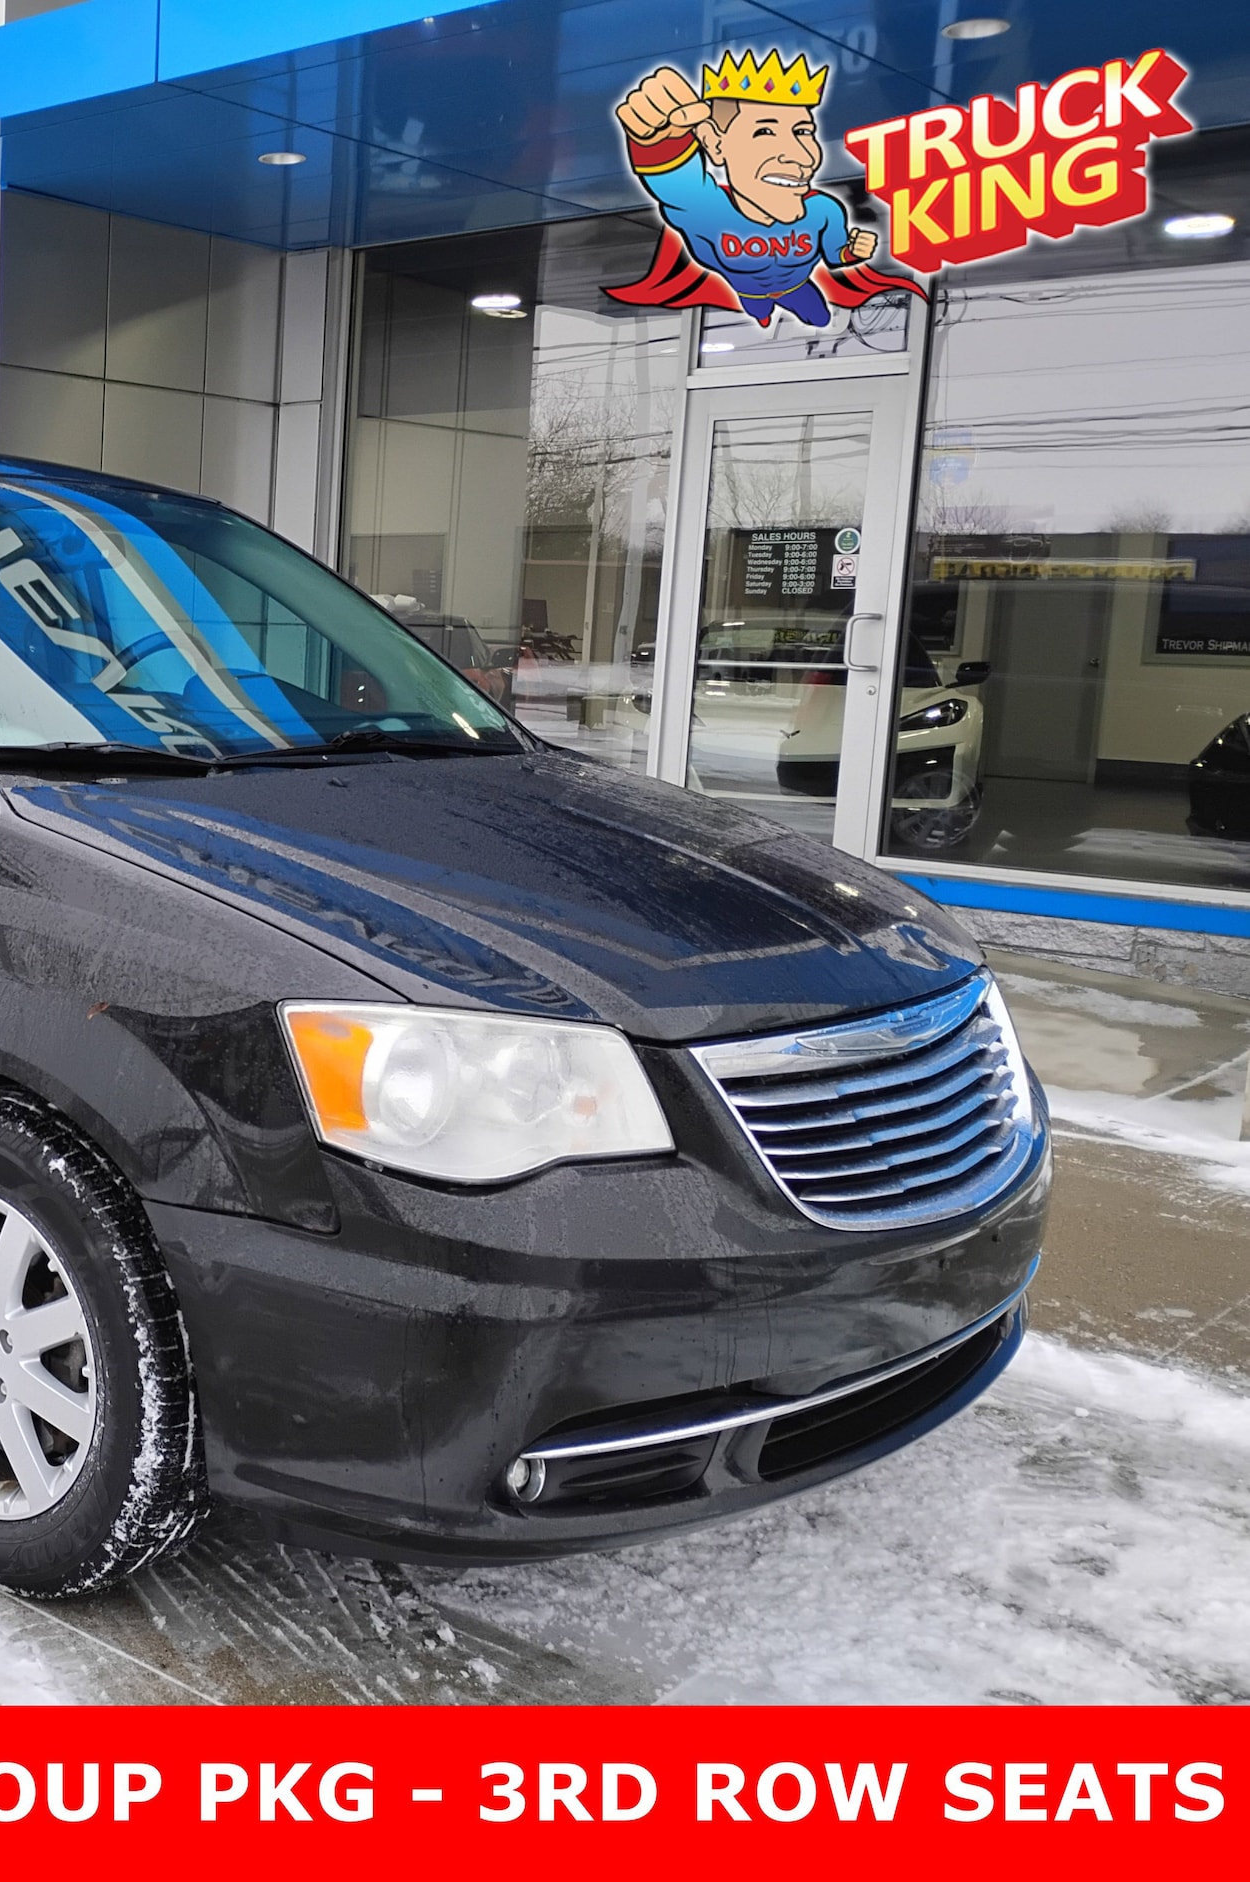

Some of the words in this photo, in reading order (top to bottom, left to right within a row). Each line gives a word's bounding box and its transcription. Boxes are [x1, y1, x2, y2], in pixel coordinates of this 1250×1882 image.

[752, 532, 781, 541] SALES
[783, 532, 817, 541] HOURS
[1162, 638, 1204, 651] TREVOR
[1207, 639, 1250, 652] SHIPMA
